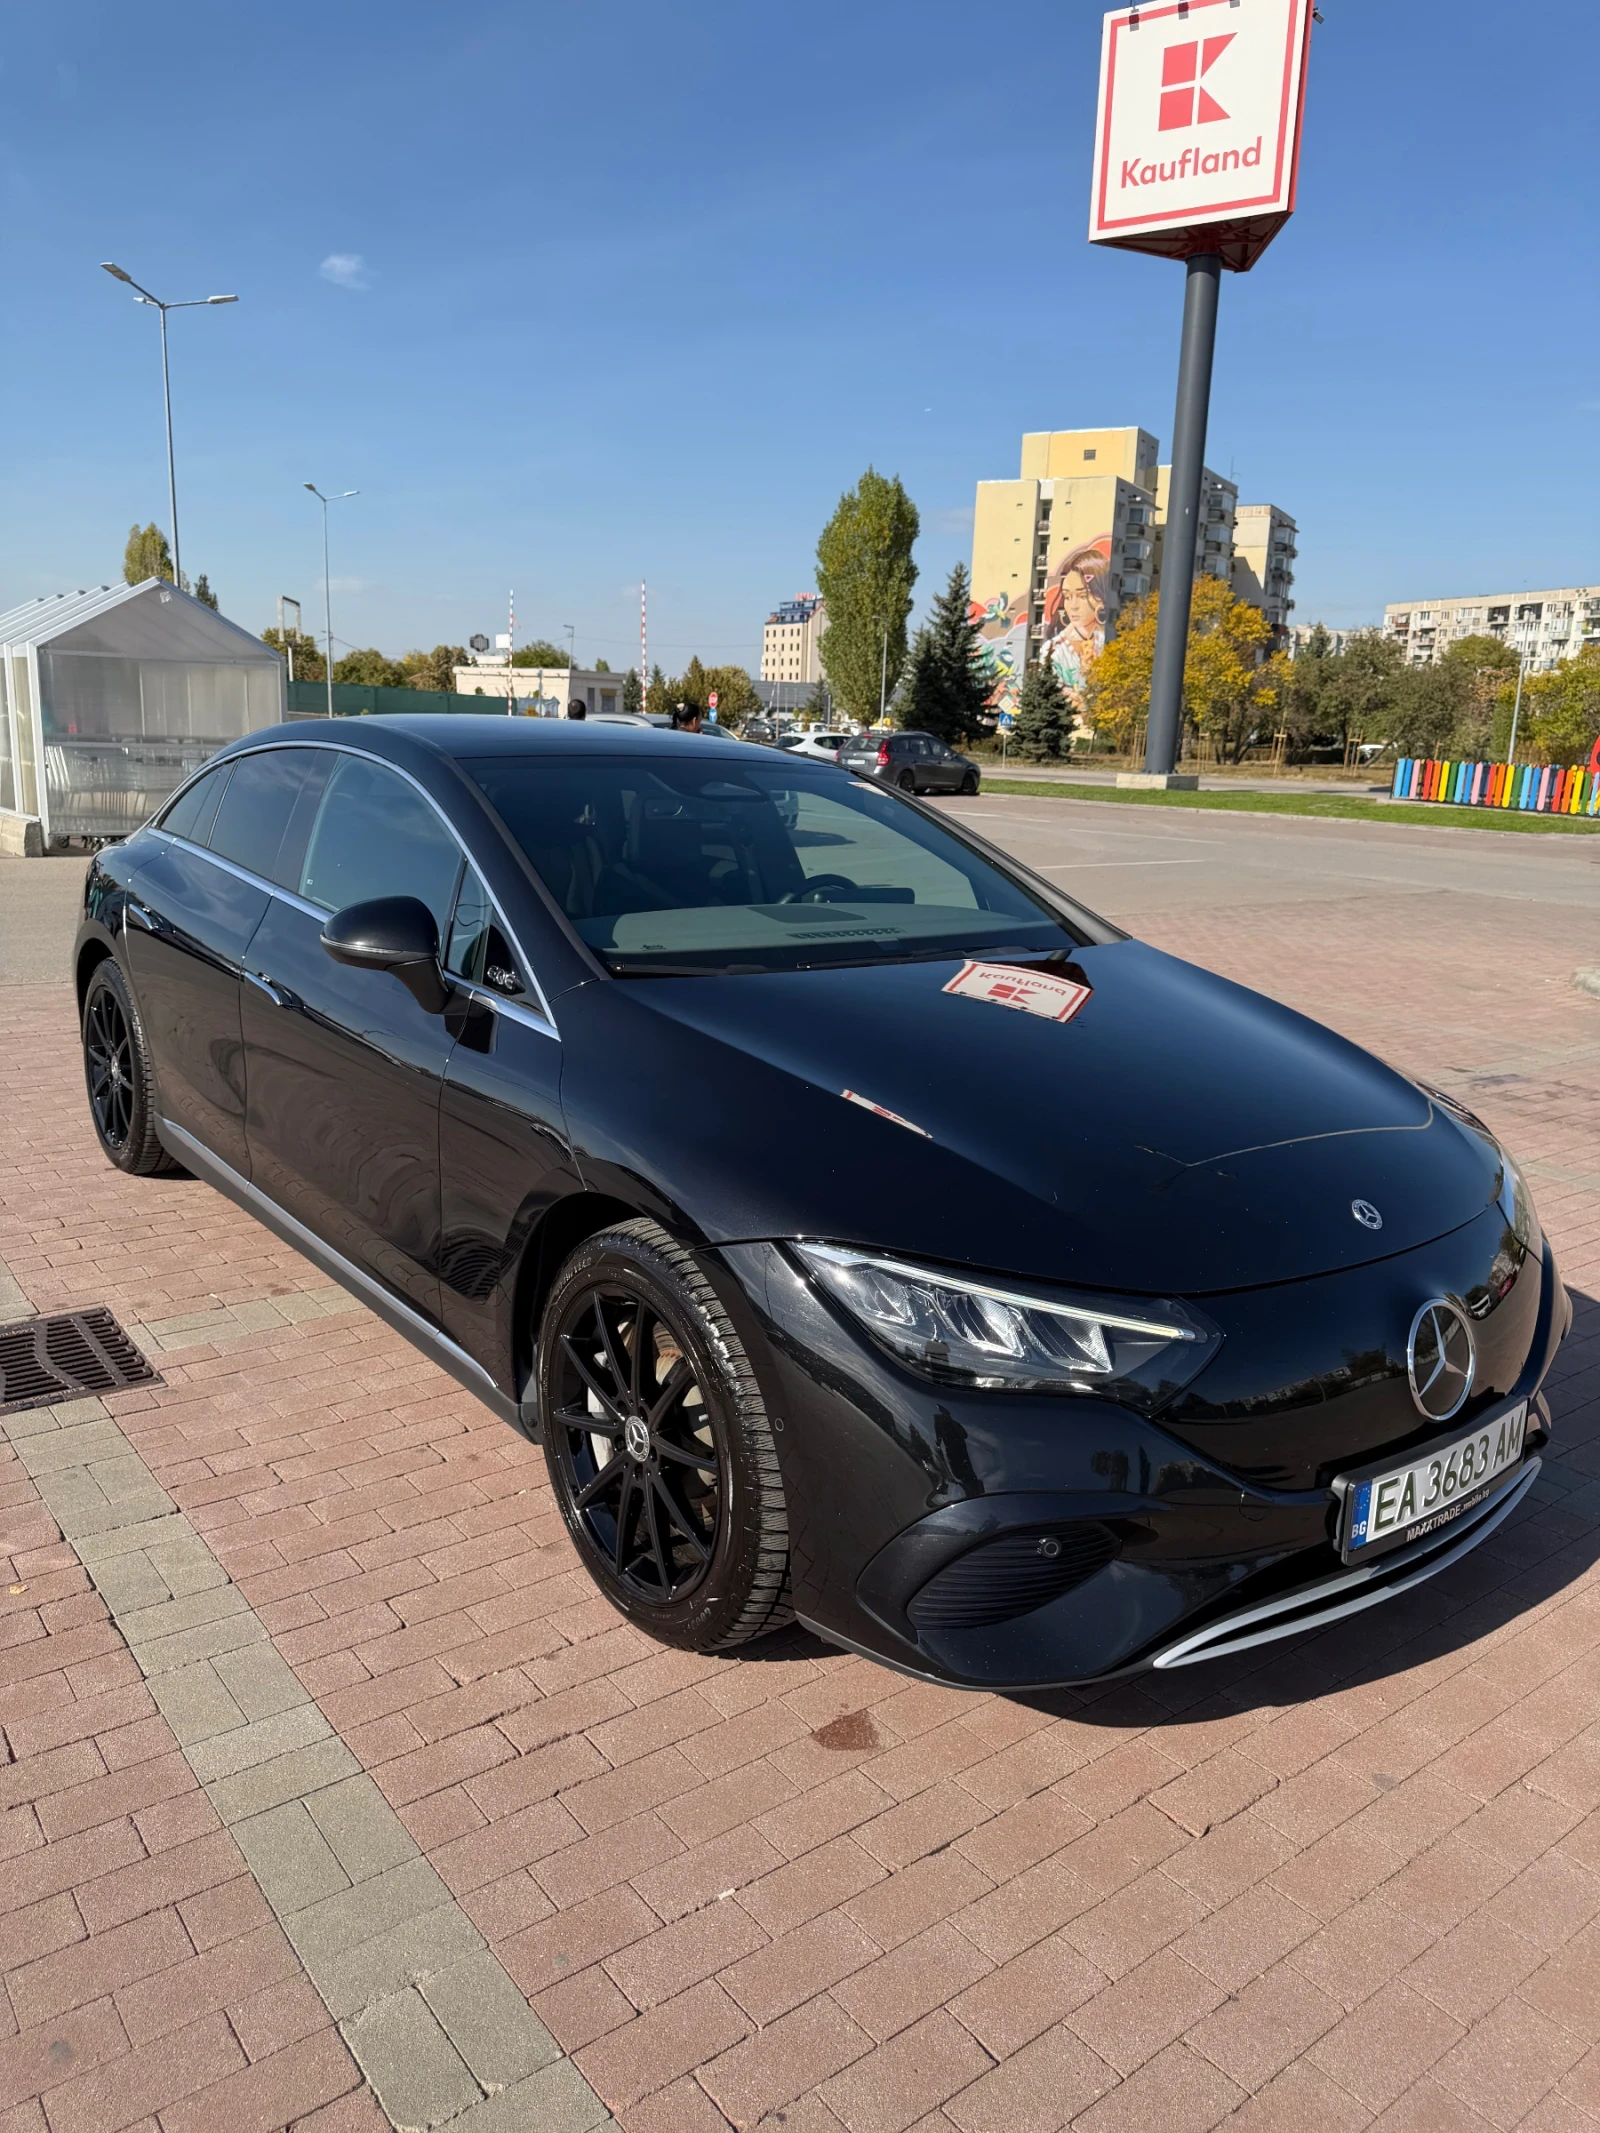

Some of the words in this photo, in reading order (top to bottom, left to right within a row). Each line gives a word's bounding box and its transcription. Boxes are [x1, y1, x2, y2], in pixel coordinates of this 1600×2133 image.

[1121, 136, 1262, 188] Kaufland
[1374, 1471, 1415, 1532] EA
[1422, 1435, 1490, 1508] 3683
[1492, 1410, 1523, 1471] AM
[1351, 1520, 1367, 1539] BG
